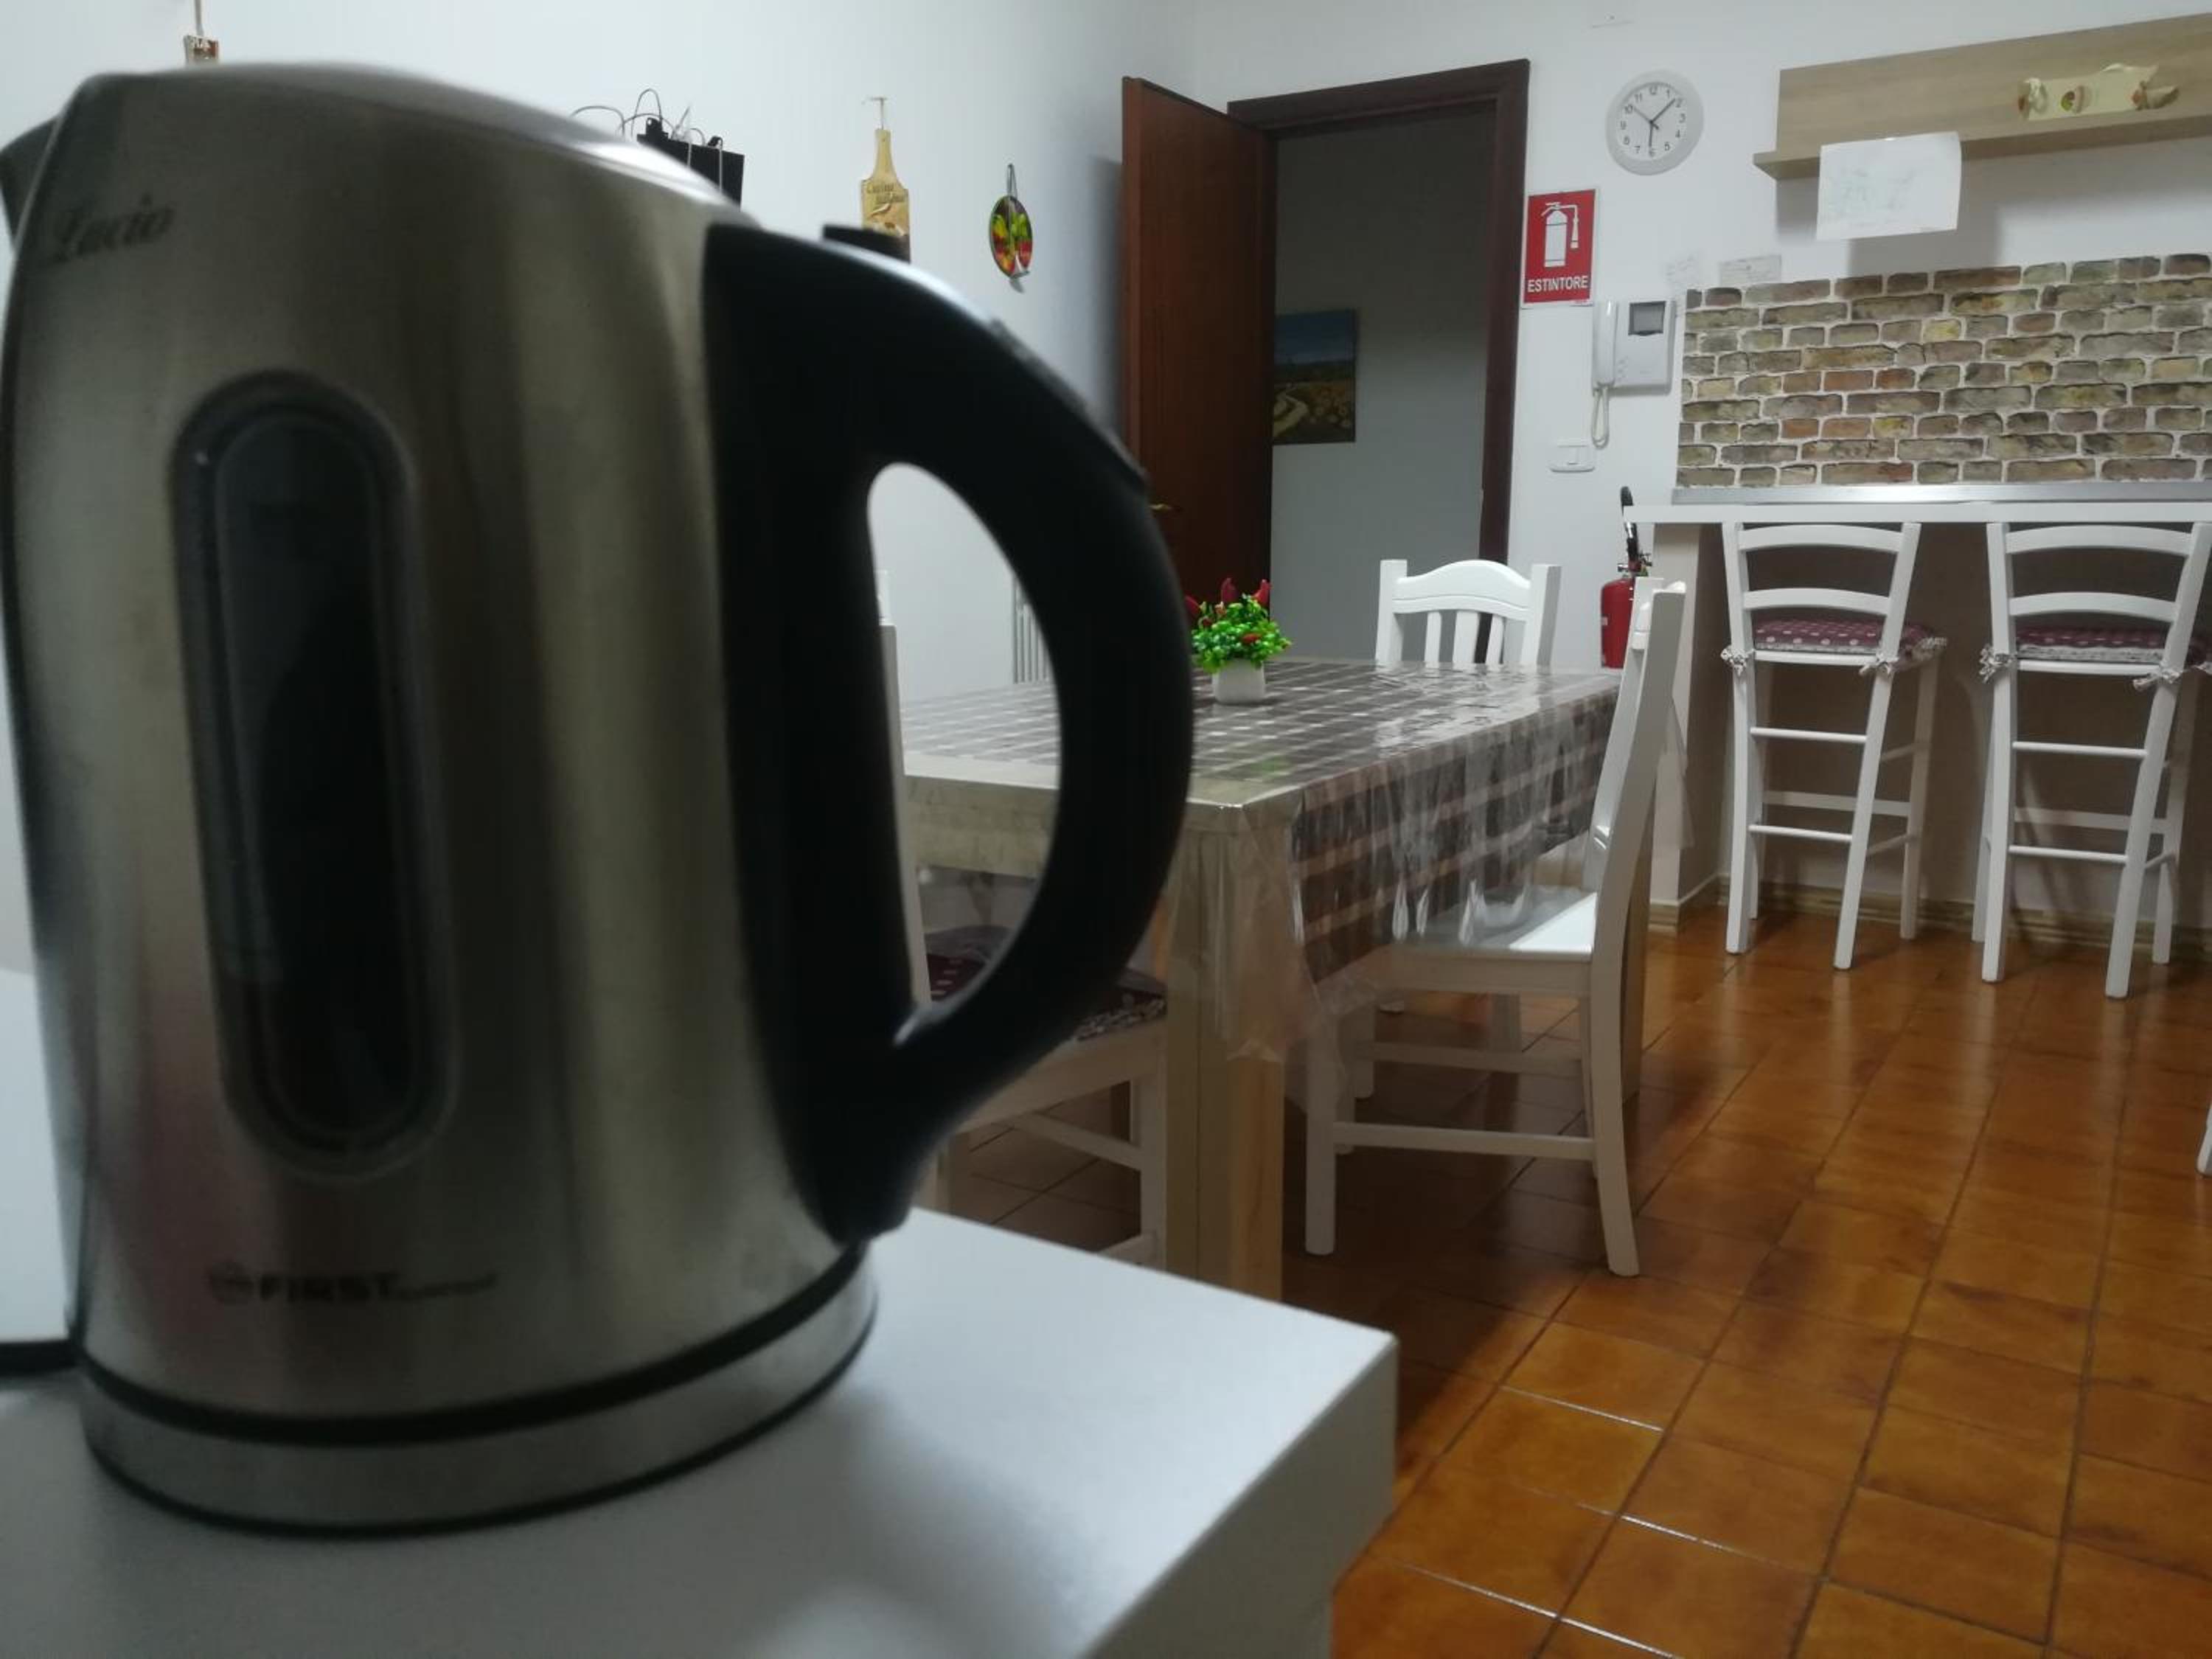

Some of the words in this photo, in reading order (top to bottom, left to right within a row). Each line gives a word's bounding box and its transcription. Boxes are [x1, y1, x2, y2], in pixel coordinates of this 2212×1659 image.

[1649, 86, 1658, 95] 12
[1634, 93, 1643, 103] 11
[1675, 97, 1683, 108] 2
[1624, 103, 1634, 114] 10
[1679, 113, 1686, 124] 3
[1620, 120, 1627, 131] 9
[1674, 129, 1681, 139] 4
[1634, 145, 1641, 154] 7
[1664, 142, 1671, 151] 5
[1528, 276, 1588, 293] ESTINTORE
[260, 1274, 398, 1302] FIRST
